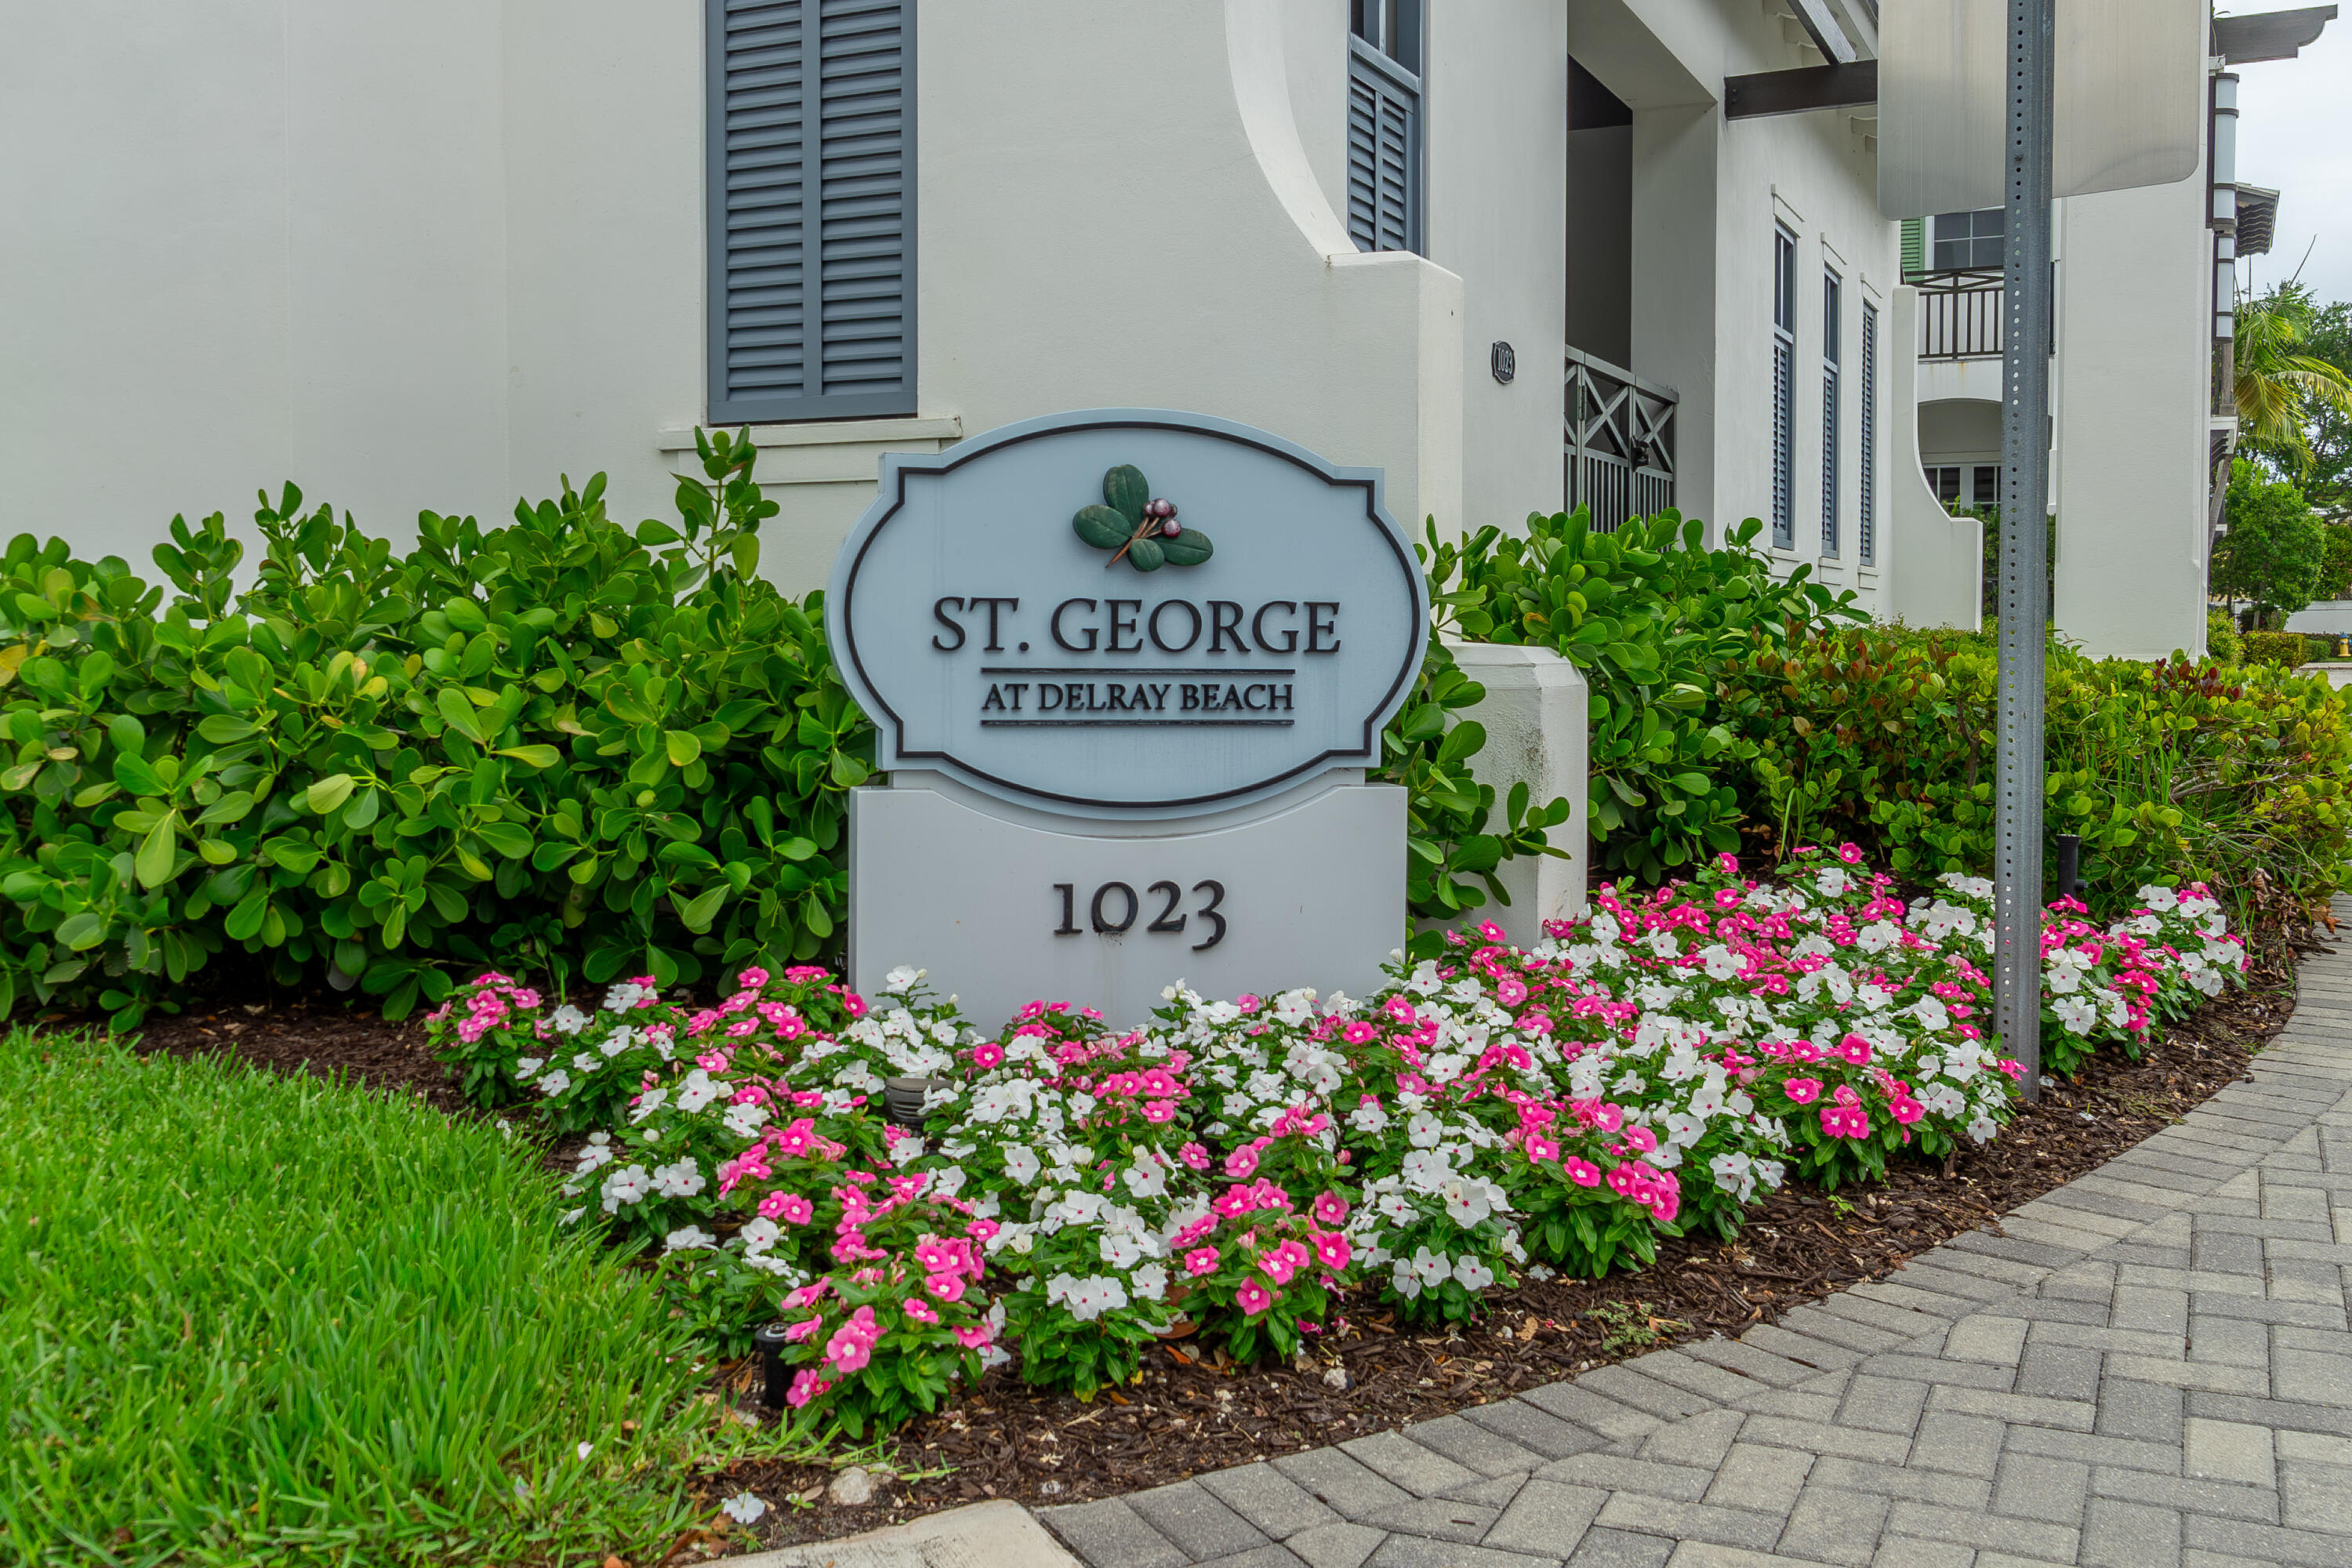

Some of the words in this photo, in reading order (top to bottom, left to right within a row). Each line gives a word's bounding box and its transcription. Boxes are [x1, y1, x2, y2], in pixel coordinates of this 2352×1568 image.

[1497, 348, 1513, 375] 1023
[931, 596, 1030, 653] ST.
[1051, 598, 1341, 654] GEORGE
[982, 683, 1029, 710] AT
[1038, 683, 1171, 710] DELRAY
[1180, 684, 1294, 710] BEACH
[1053, 879, 1227, 951] 1023
